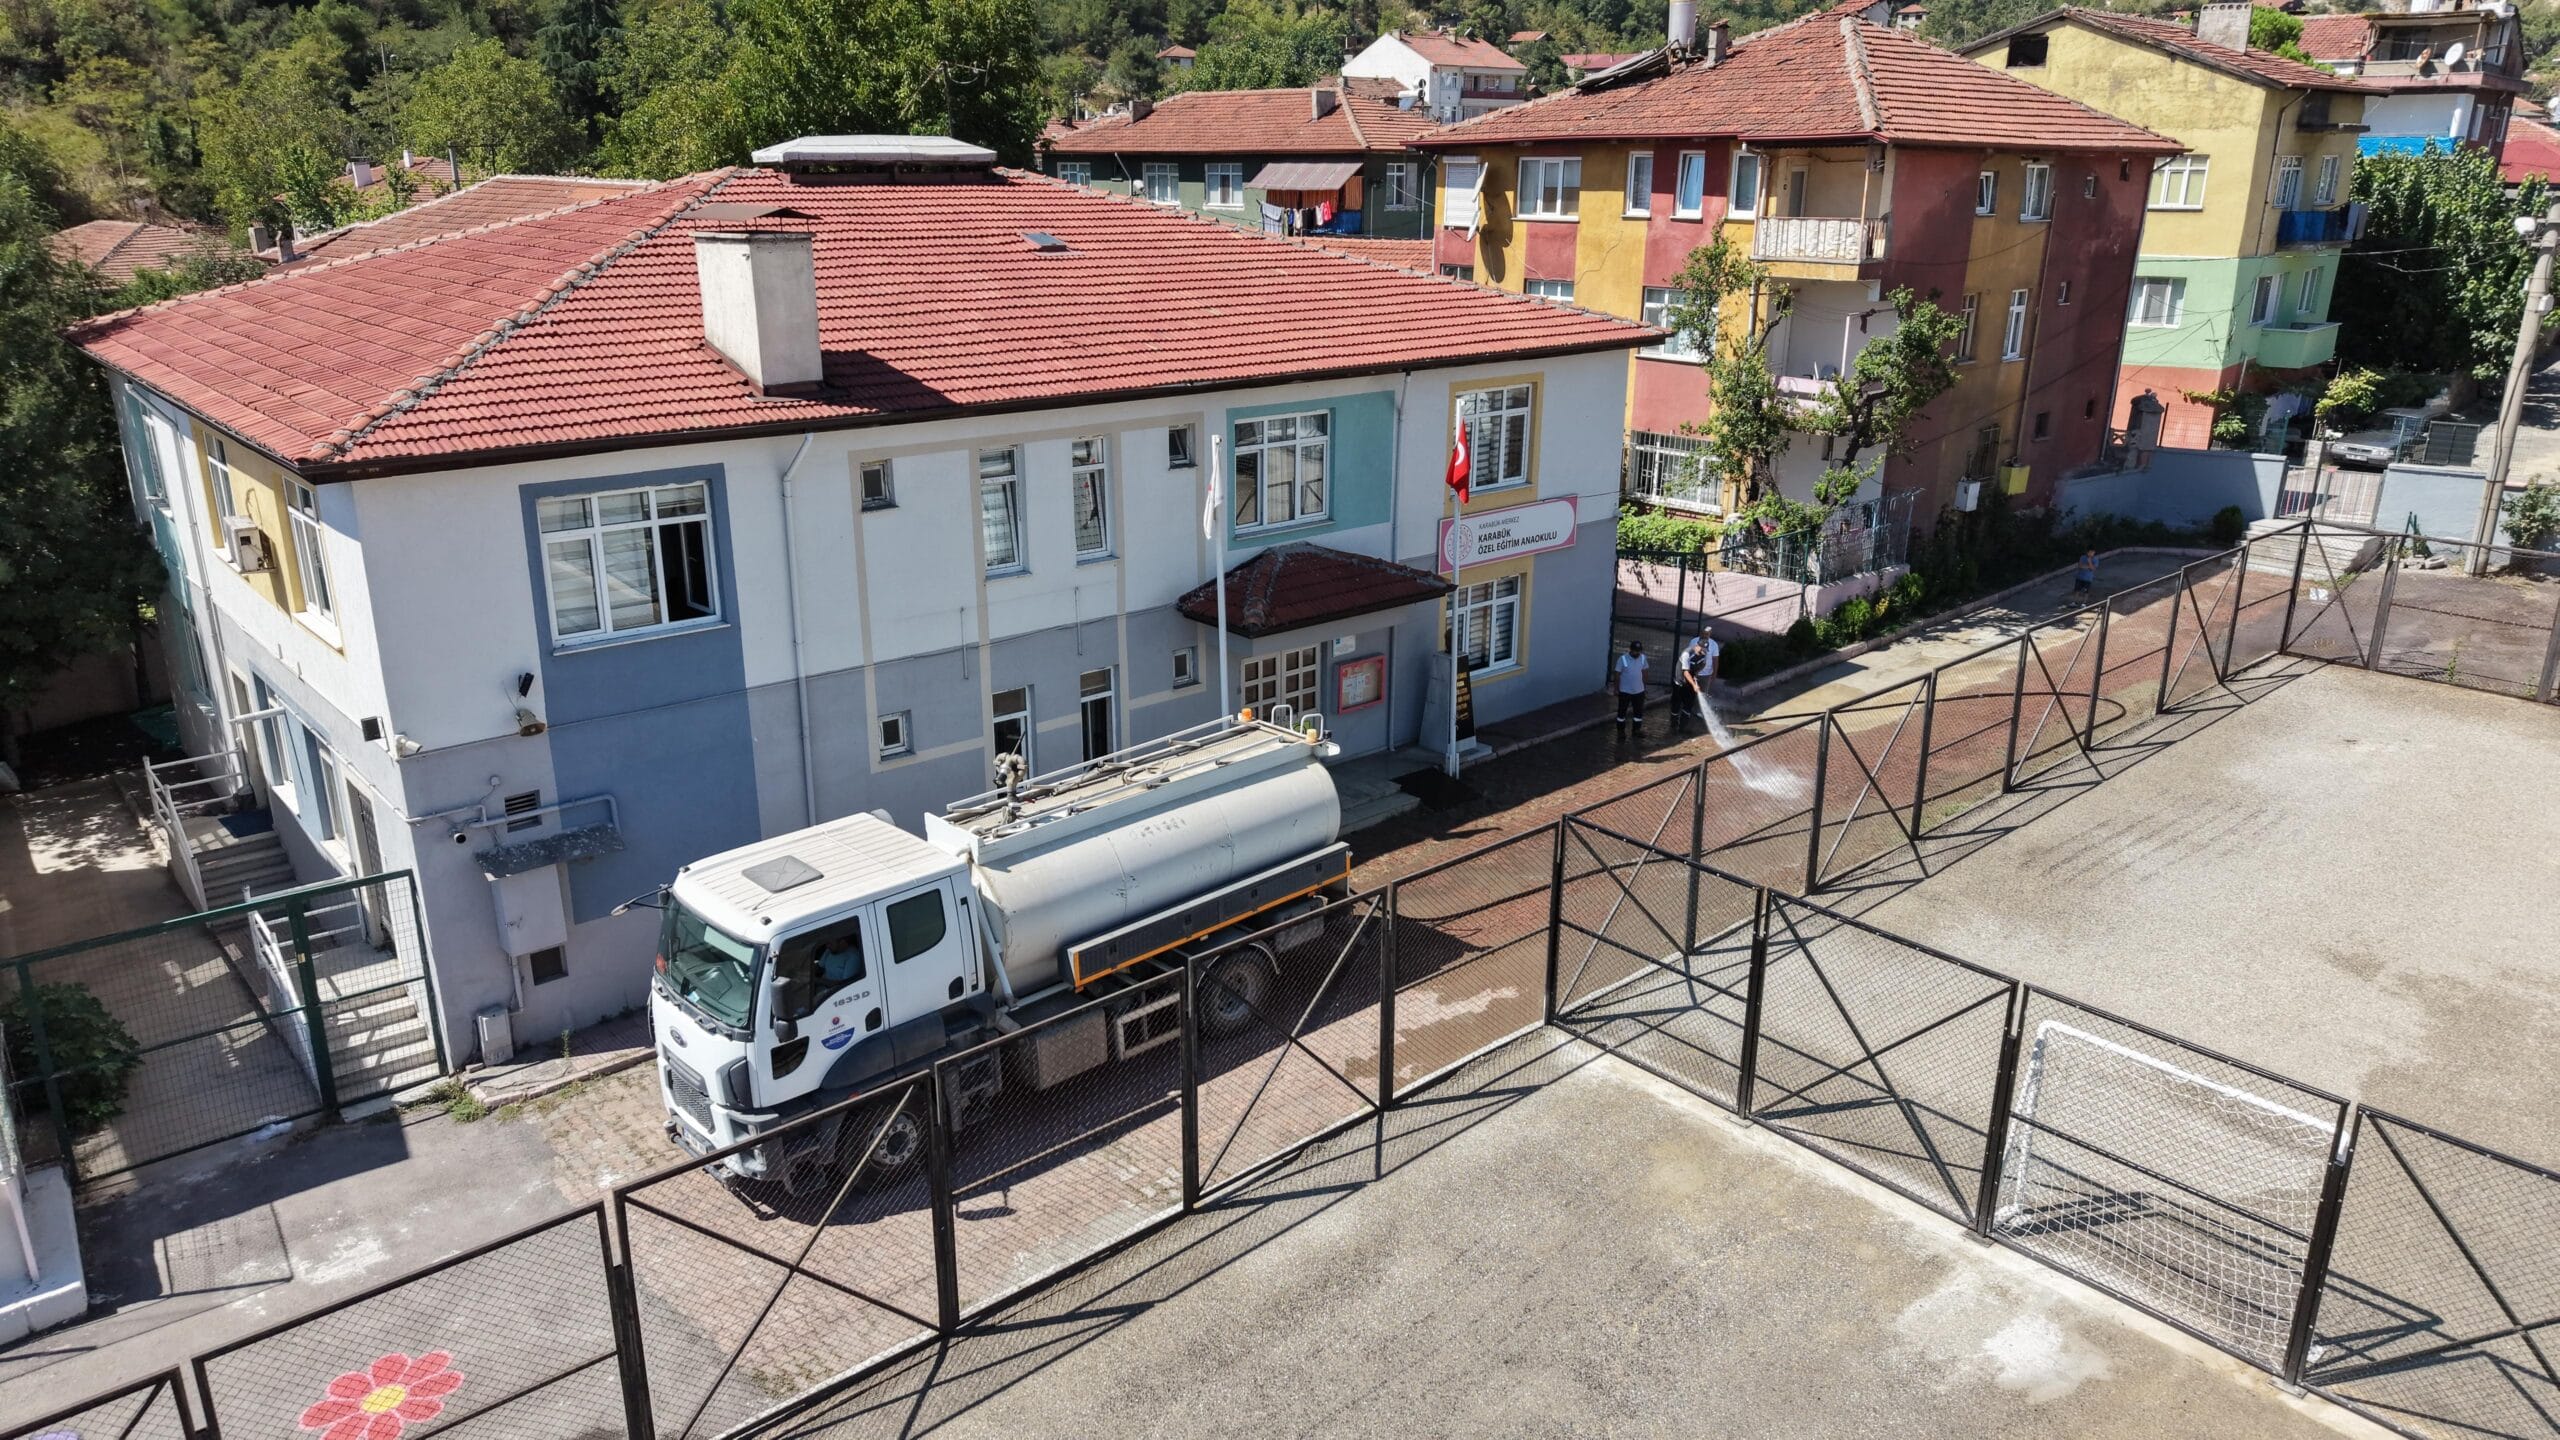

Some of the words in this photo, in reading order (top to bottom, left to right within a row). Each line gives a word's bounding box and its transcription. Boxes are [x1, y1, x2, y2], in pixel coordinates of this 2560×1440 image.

[1478, 528, 1511, 543] KARABÜK
[1478, 543, 1495, 555] ÖZEL
[1497, 538, 1520, 551] EĞİTİM
[1521, 530, 1558, 546] ANAOKULU
